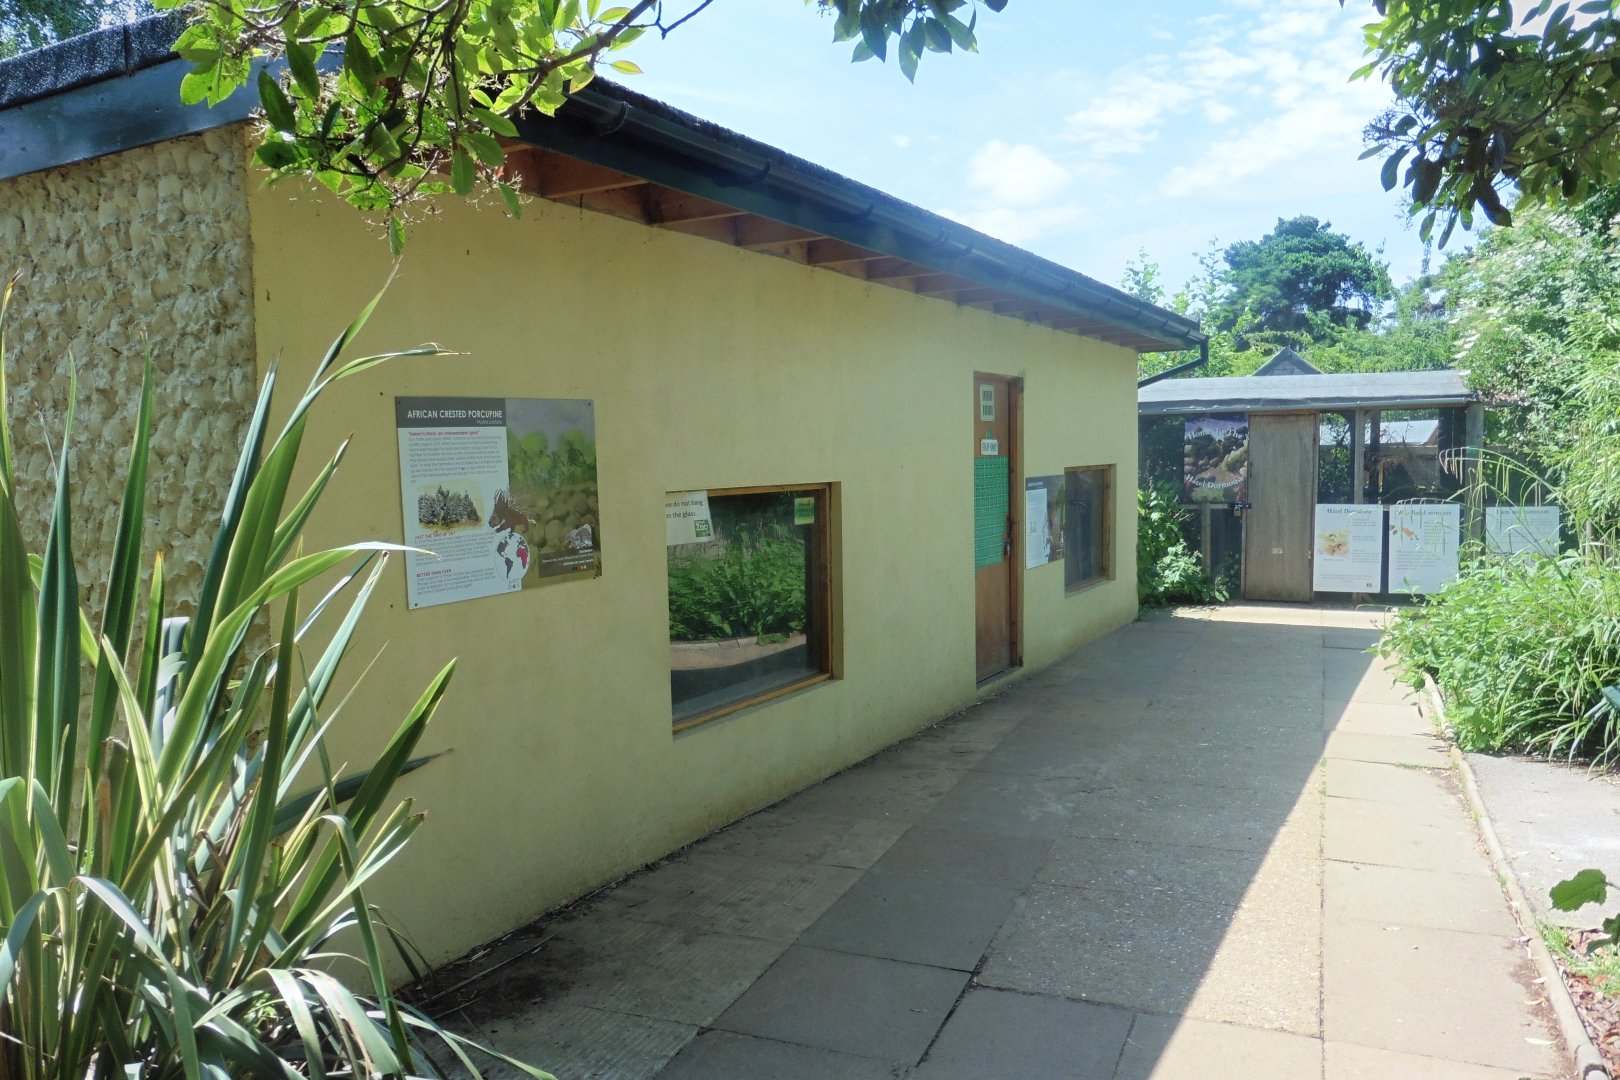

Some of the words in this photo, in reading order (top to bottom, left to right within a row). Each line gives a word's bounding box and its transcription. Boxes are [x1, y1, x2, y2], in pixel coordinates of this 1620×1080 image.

[407, 410, 438, 418] AFRICAN
[439, 410, 467, 418] CRESTED
[468, 410, 503, 418] PORCUPINE
[1187, 429, 1212, 439] Hom
[1227, 429, 1243, 439] The
[1186, 474, 1206, 487] Hazel
[1207, 476, 1245, 488] Dormouse
[695, 523, 709, 531] Zoo
